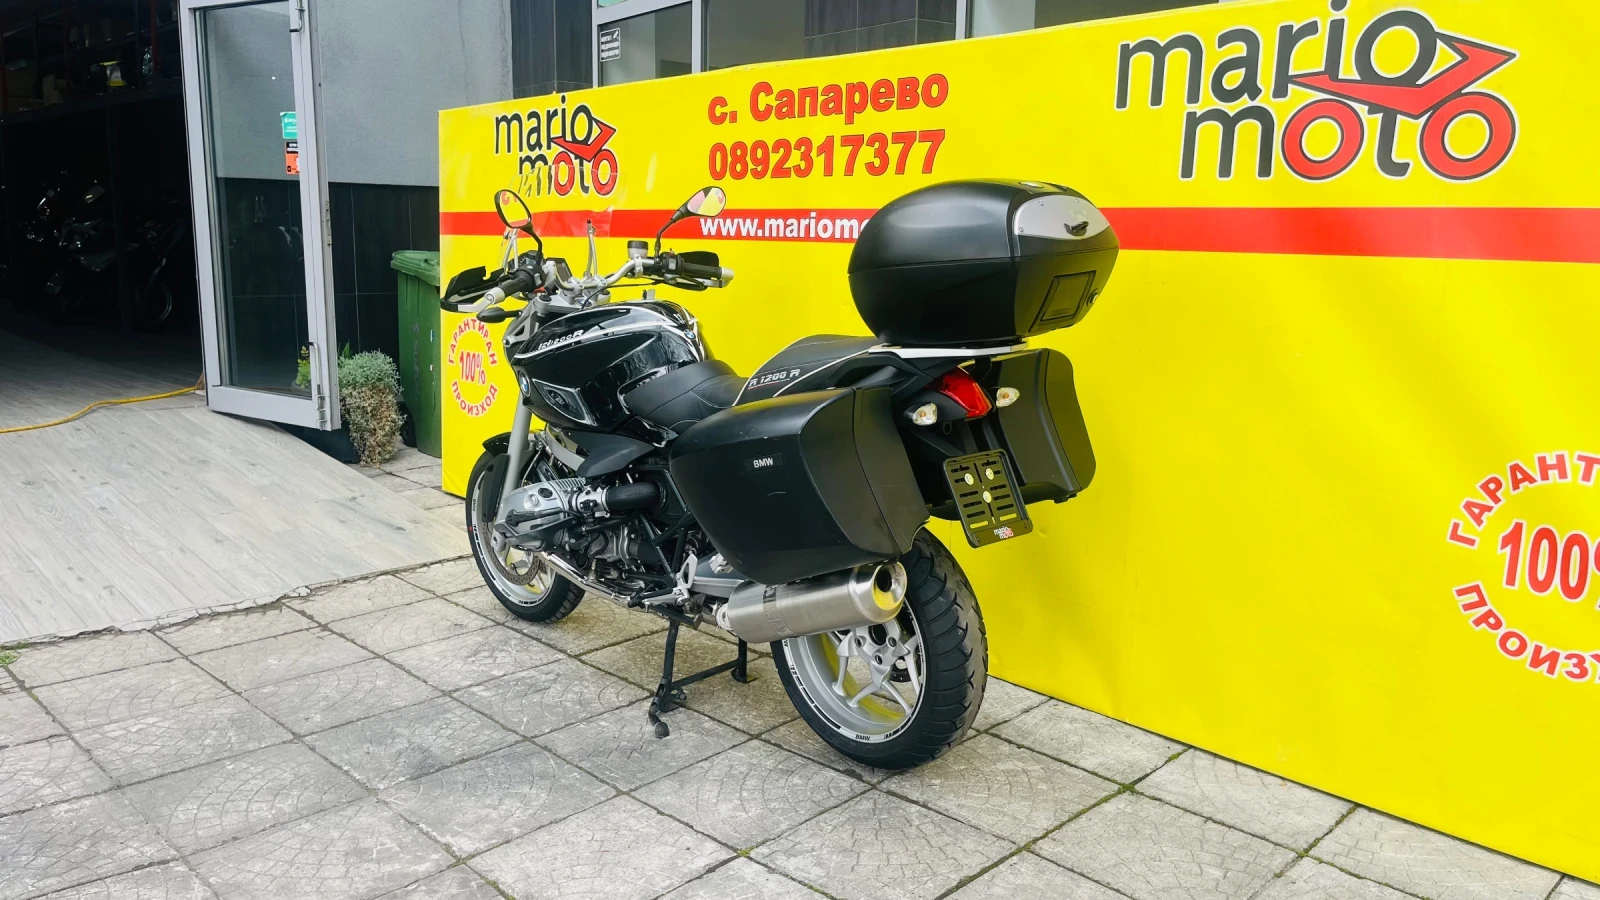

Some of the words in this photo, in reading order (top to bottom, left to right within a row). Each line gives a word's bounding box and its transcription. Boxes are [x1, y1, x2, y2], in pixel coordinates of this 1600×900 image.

[1115, 0, 1438, 109] mario
[750, 73, 949, 125] Сапарево
[495, 94, 594, 154] mario
[1179, 91, 1517, 181] moto
[519, 148, 618, 197] moto
[708, 129, 946, 180] 0892317377
[448, 318, 498, 365] ГАРАНТИРАН
[459, 350, 486, 385] 100%
[760, 371, 787, 383] 1200
[452, 380, 498, 416] ПРОИЗХОД
[753, 457, 774, 468] BMW
